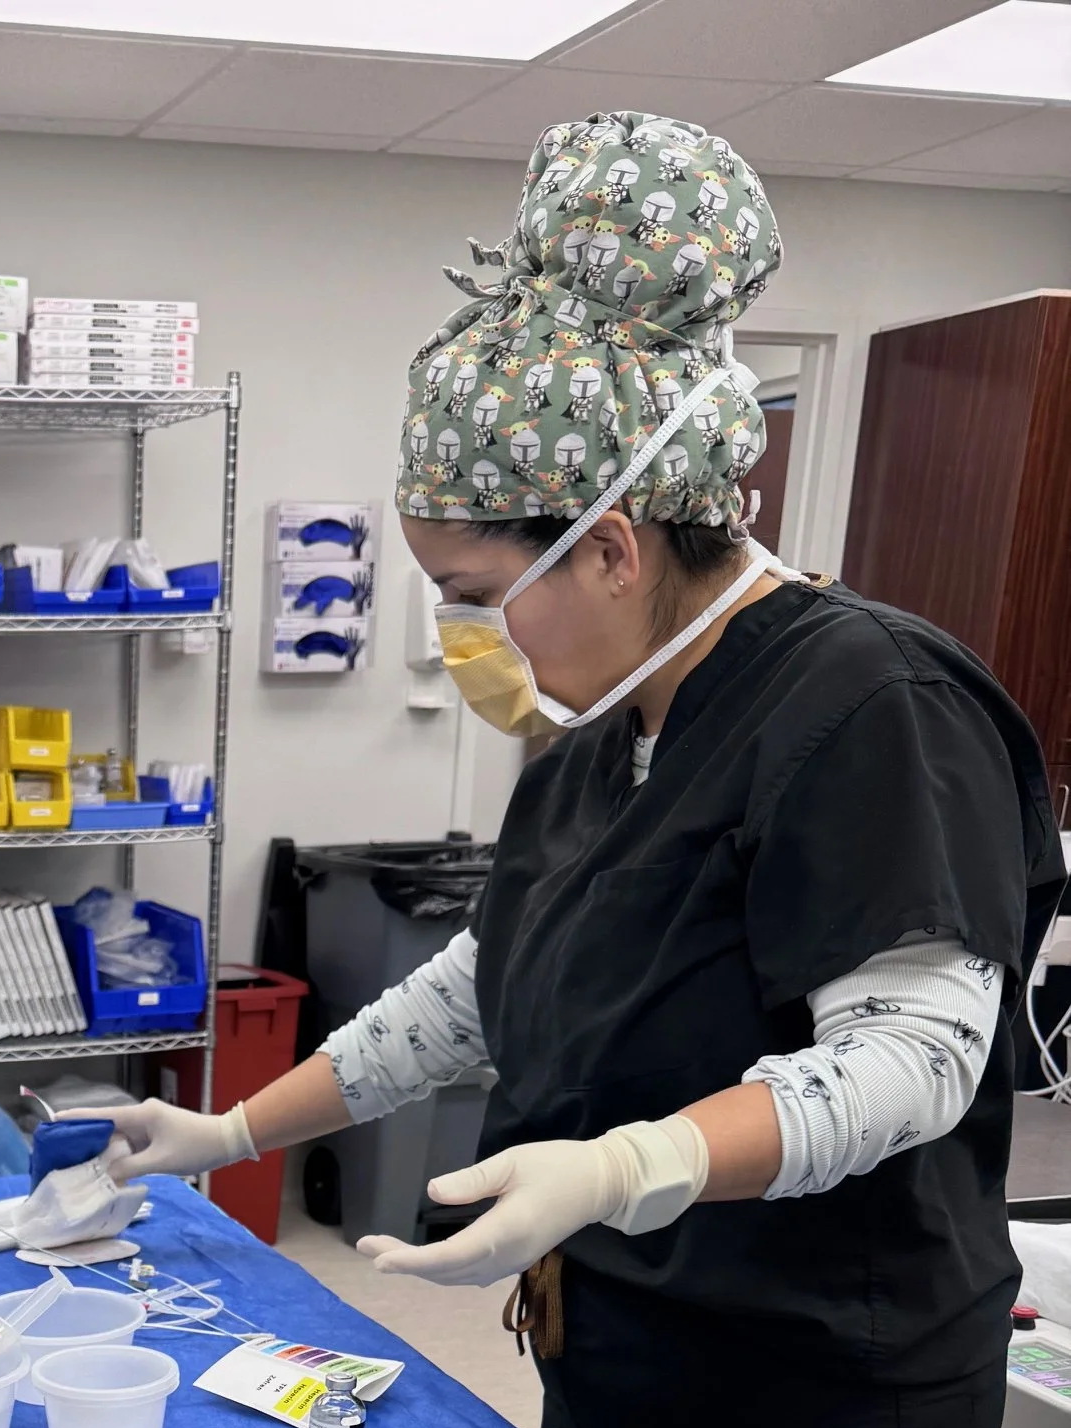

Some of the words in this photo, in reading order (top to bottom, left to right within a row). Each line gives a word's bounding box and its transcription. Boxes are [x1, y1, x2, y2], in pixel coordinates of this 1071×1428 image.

[256, 1374, 277, 1391] Zofran
[274, 1383, 288, 1393] TPA
[283, 1383, 307, 1404] Heparin
[298, 1388, 322, 1410] Heparin
